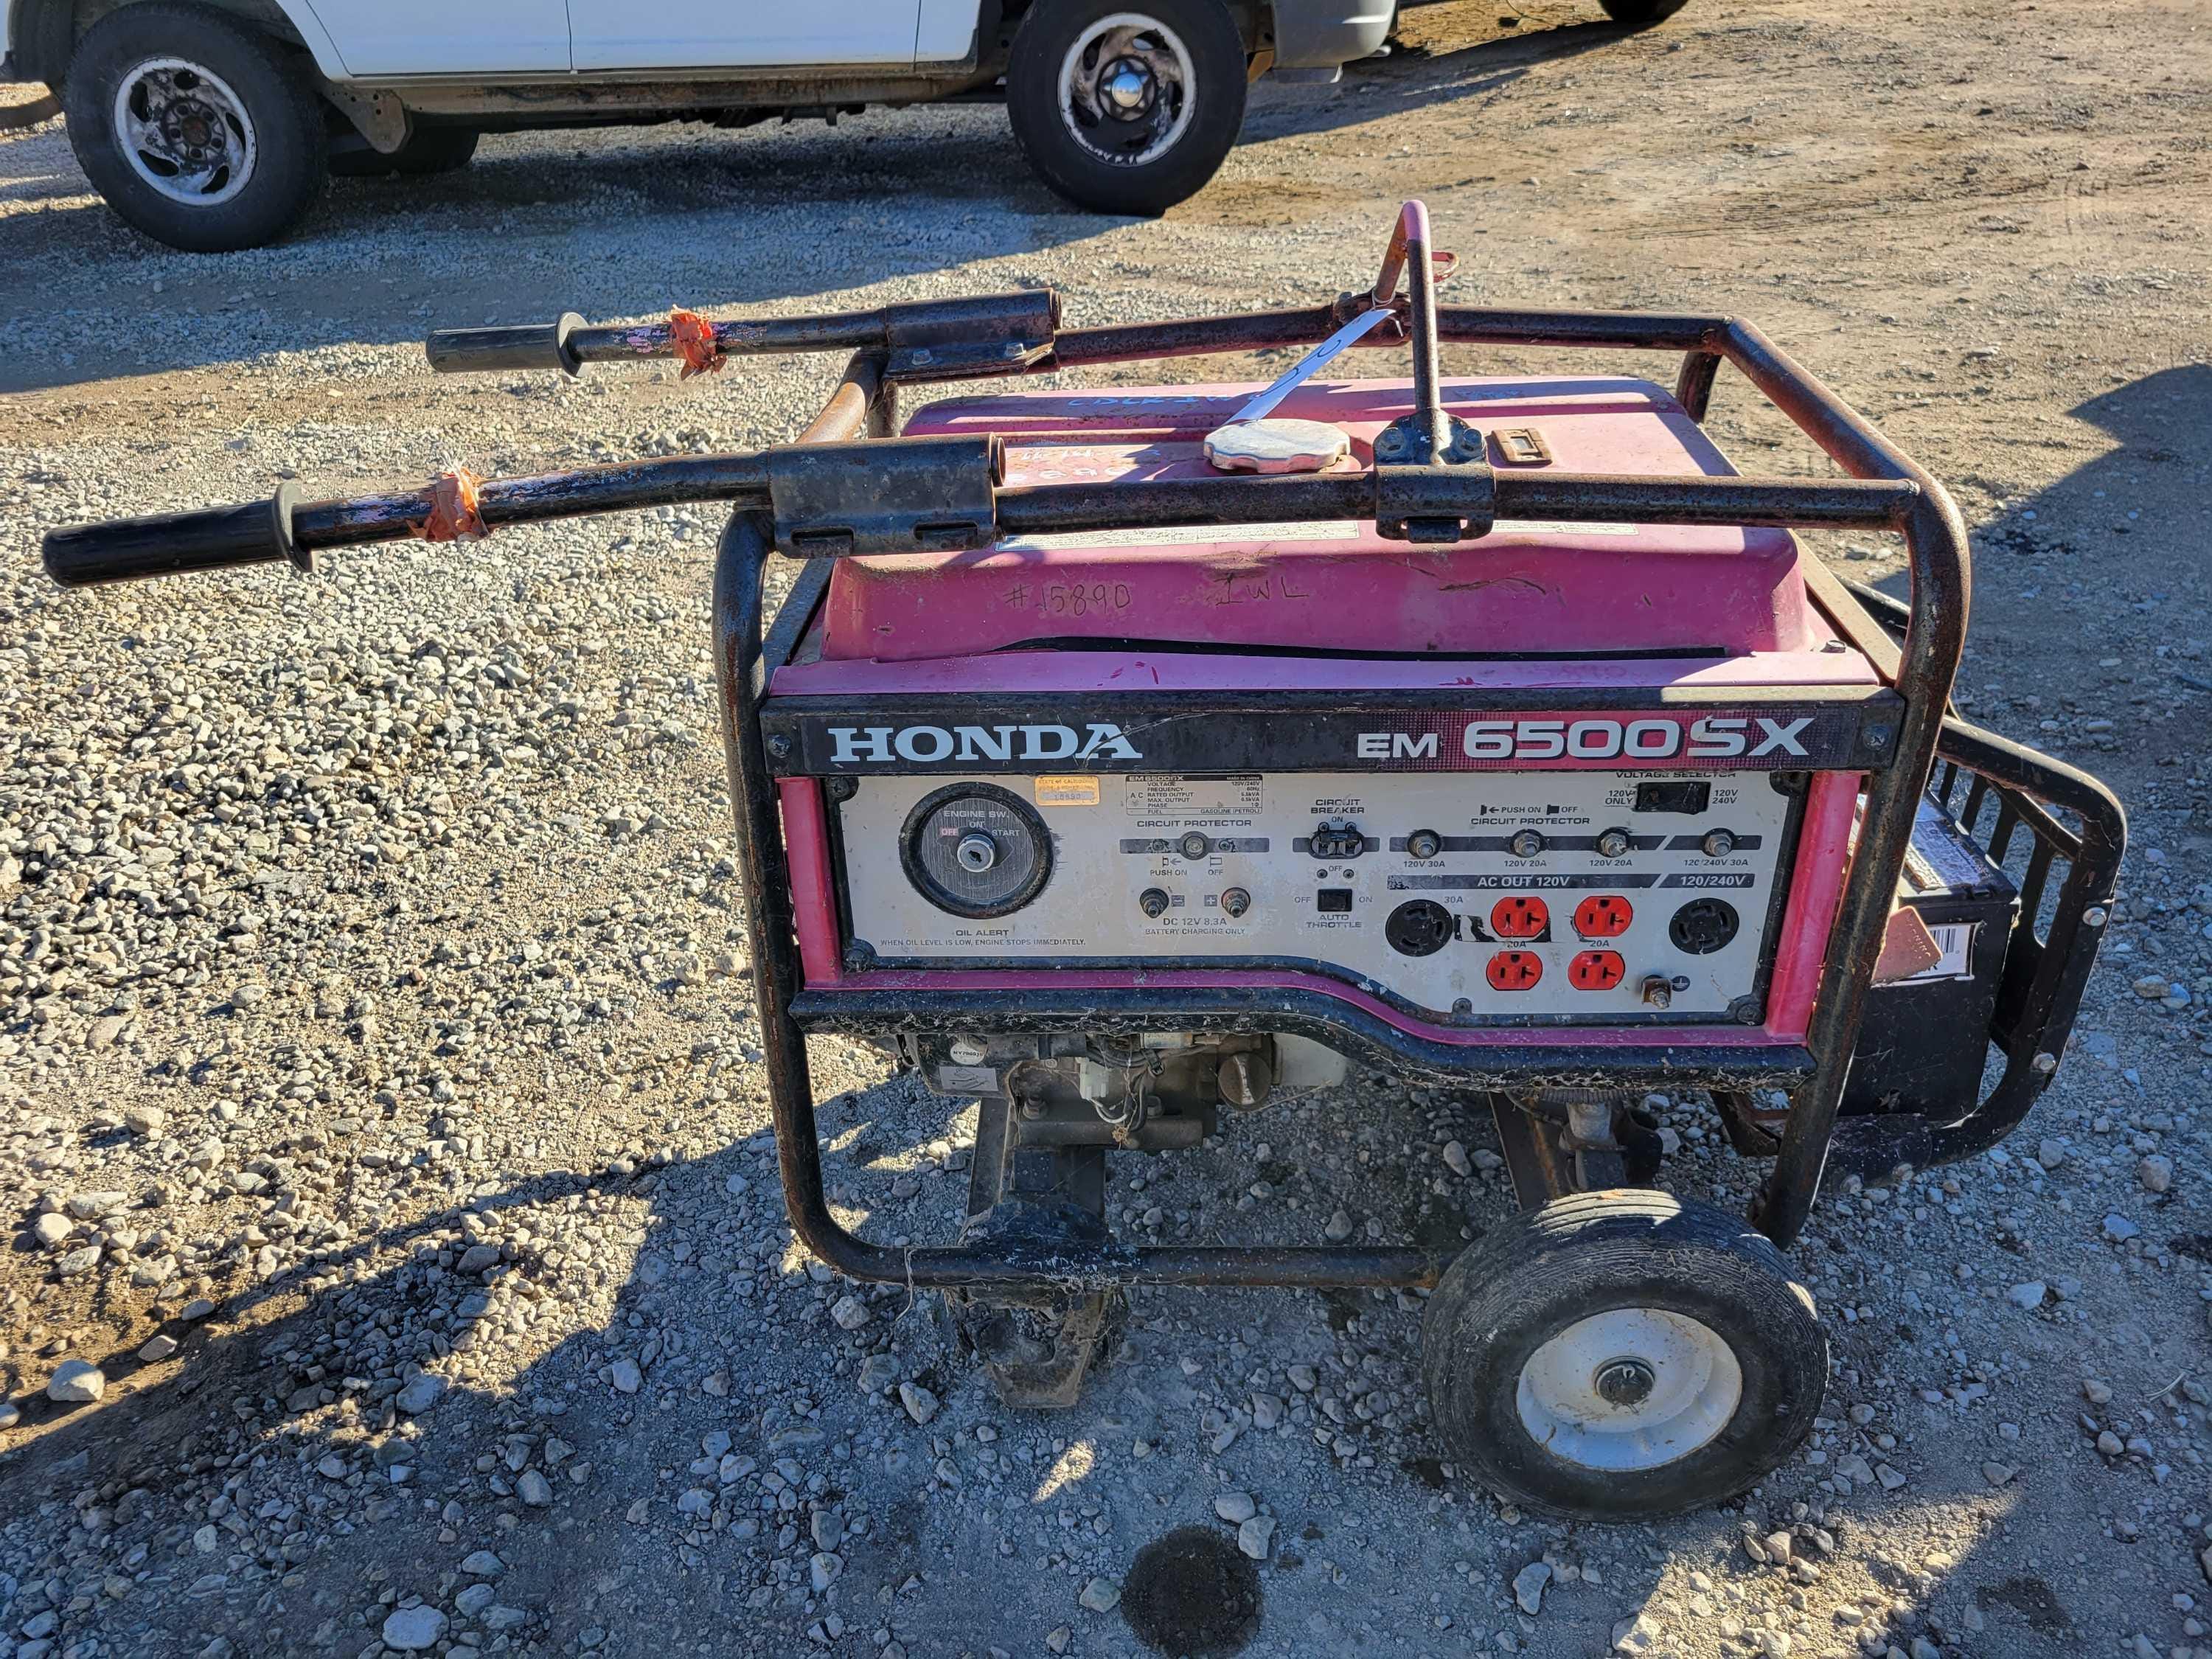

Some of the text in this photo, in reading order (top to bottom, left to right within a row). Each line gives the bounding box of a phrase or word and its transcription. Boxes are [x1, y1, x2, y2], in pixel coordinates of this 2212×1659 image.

[1003, 583, 1132, 616] #15890
[827, 723, 1143, 762] HONDA
[1357, 718, 1815, 758] EM 6500SX
[1478, 876, 1571, 887] AC OUT 120V
[1681, 876, 1747, 886] 120/240V
[1444, 896, 1464, 904] 30A
